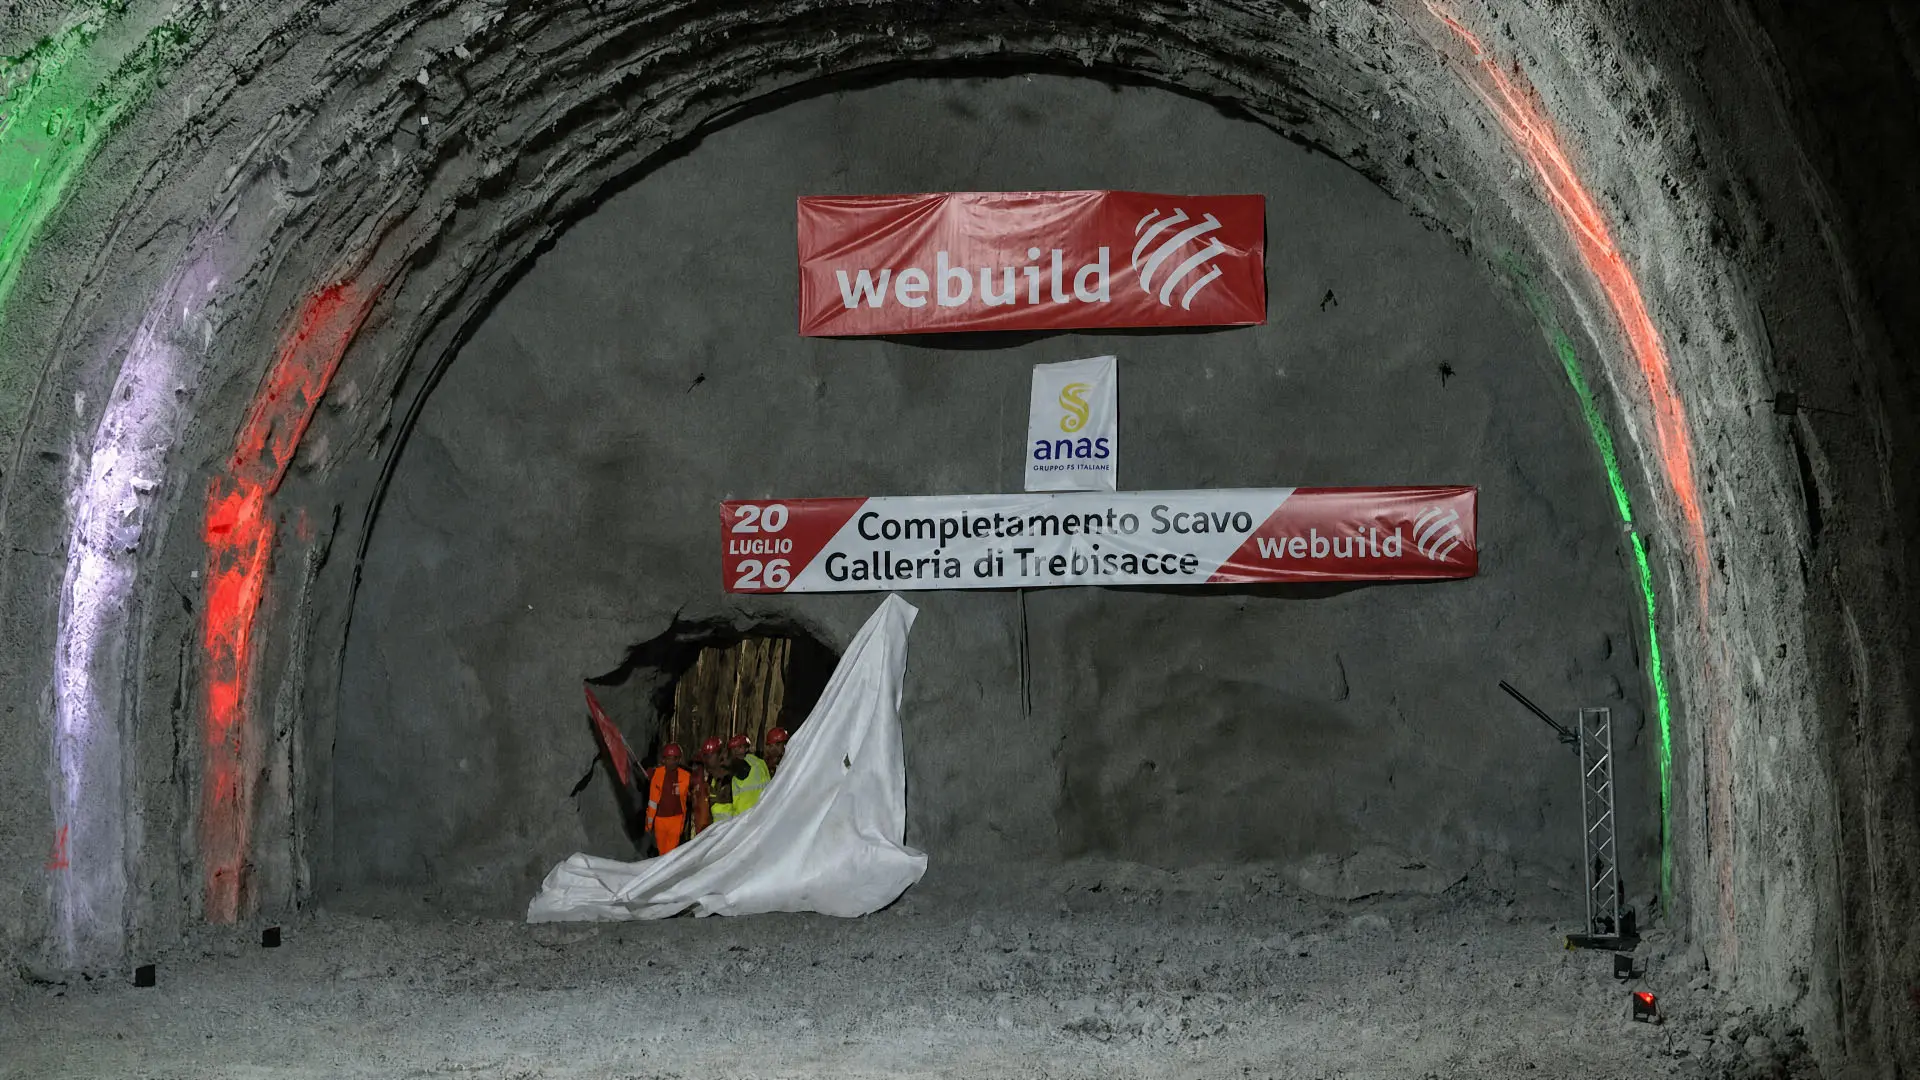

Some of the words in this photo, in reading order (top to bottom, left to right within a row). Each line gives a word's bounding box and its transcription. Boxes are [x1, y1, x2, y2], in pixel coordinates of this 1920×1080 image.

[836, 247, 1111, 309] webuild
[1033, 437, 1110, 460] anas
[731, 503, 789, 534] 20
[857, 507, 1140, 548] Completamento
[1150, 504, 1253, 535] Scavo
[729, 538, 793, 555] LUGLIO
[1256, 526, 1402, 559] webuild
[733, 558, 791, 589] 26
[824, 549, 962, 582] Galleria
[973, 547, 1004, 578] di
[1013, 543, 1199, 577] Trebisacce
